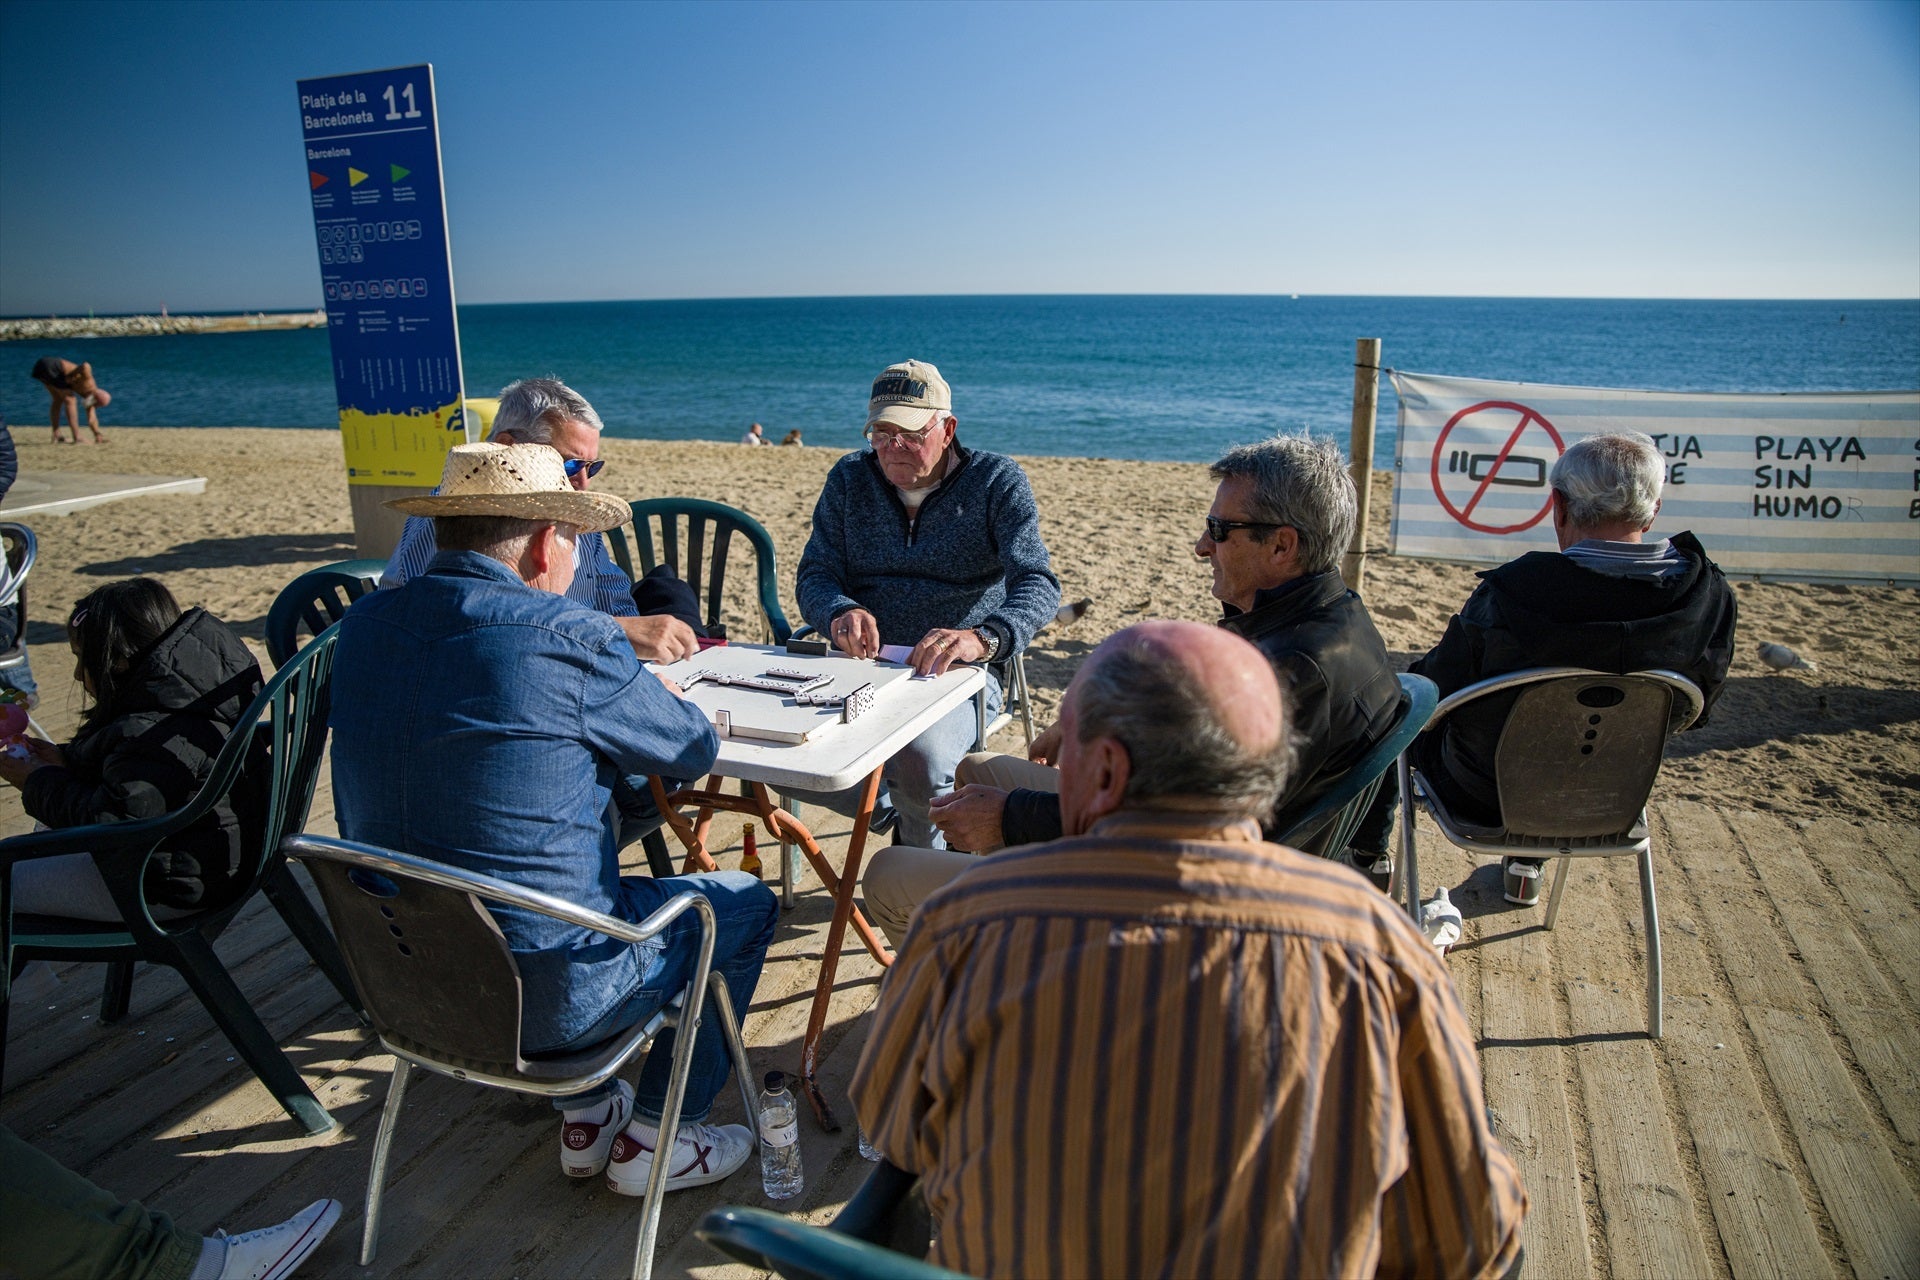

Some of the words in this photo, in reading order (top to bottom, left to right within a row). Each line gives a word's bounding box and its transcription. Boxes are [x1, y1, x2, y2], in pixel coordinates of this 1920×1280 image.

[302, 94, 336, 110] Platja
[338, 91, 353, 105] de
[355, 89, 367, 103] la
[382, 82, 422, 120] 11
[304, 110, 374, 129] Barceloneta
[308, 147, 351, 159] Barcelona
[1650, 433, 1703, 459] TJA
[1754, 435, 1866, 462] PLAYA
[1754, 463, 1812, 490] SIN
